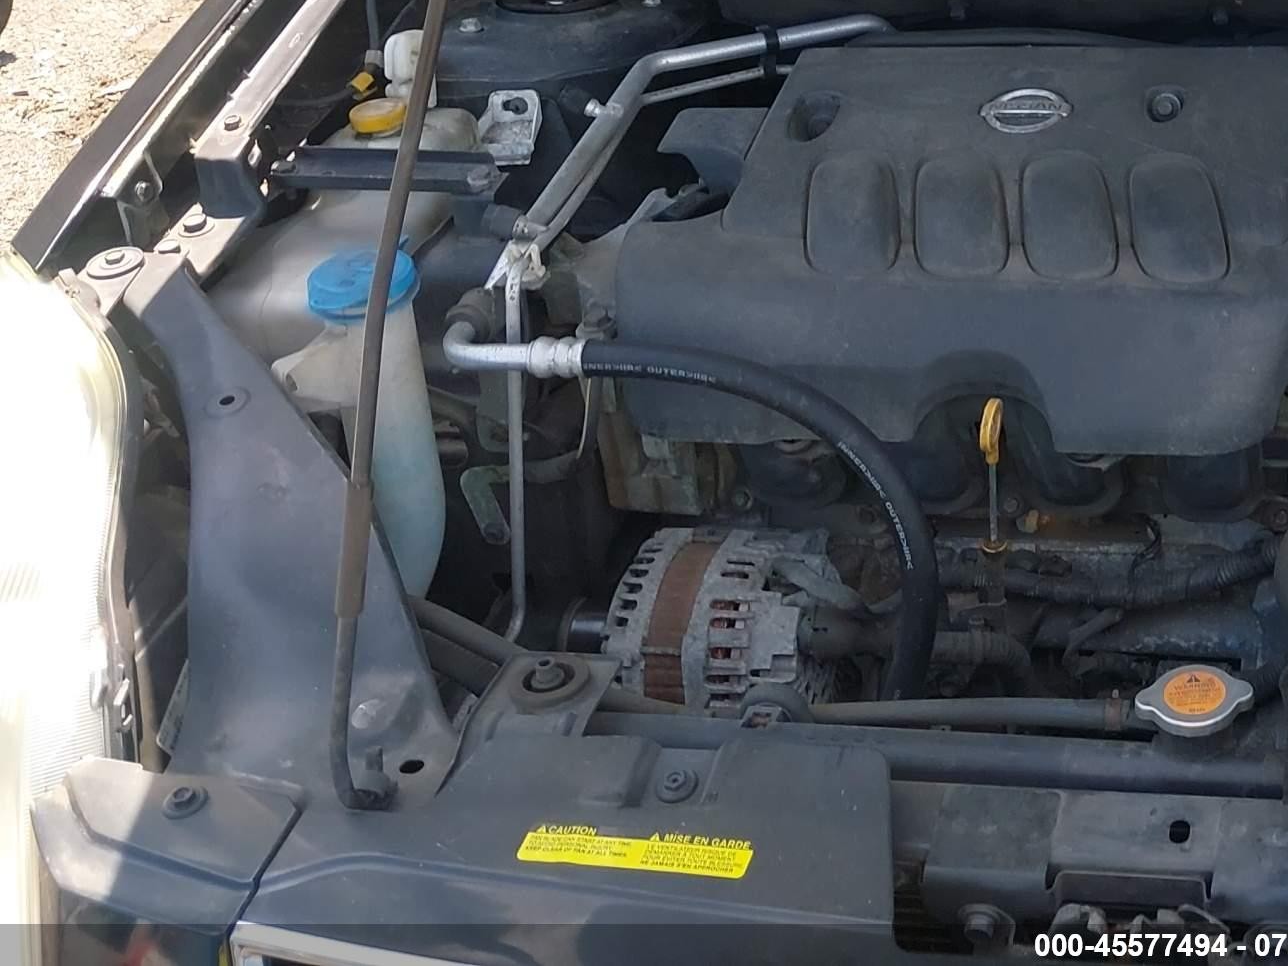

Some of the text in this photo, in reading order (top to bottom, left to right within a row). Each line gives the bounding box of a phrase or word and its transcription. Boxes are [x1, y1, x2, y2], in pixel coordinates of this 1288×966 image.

[548, 825, 597, 836] CAUTION
[664, 833, 752, 850] MISE EN GARDE
